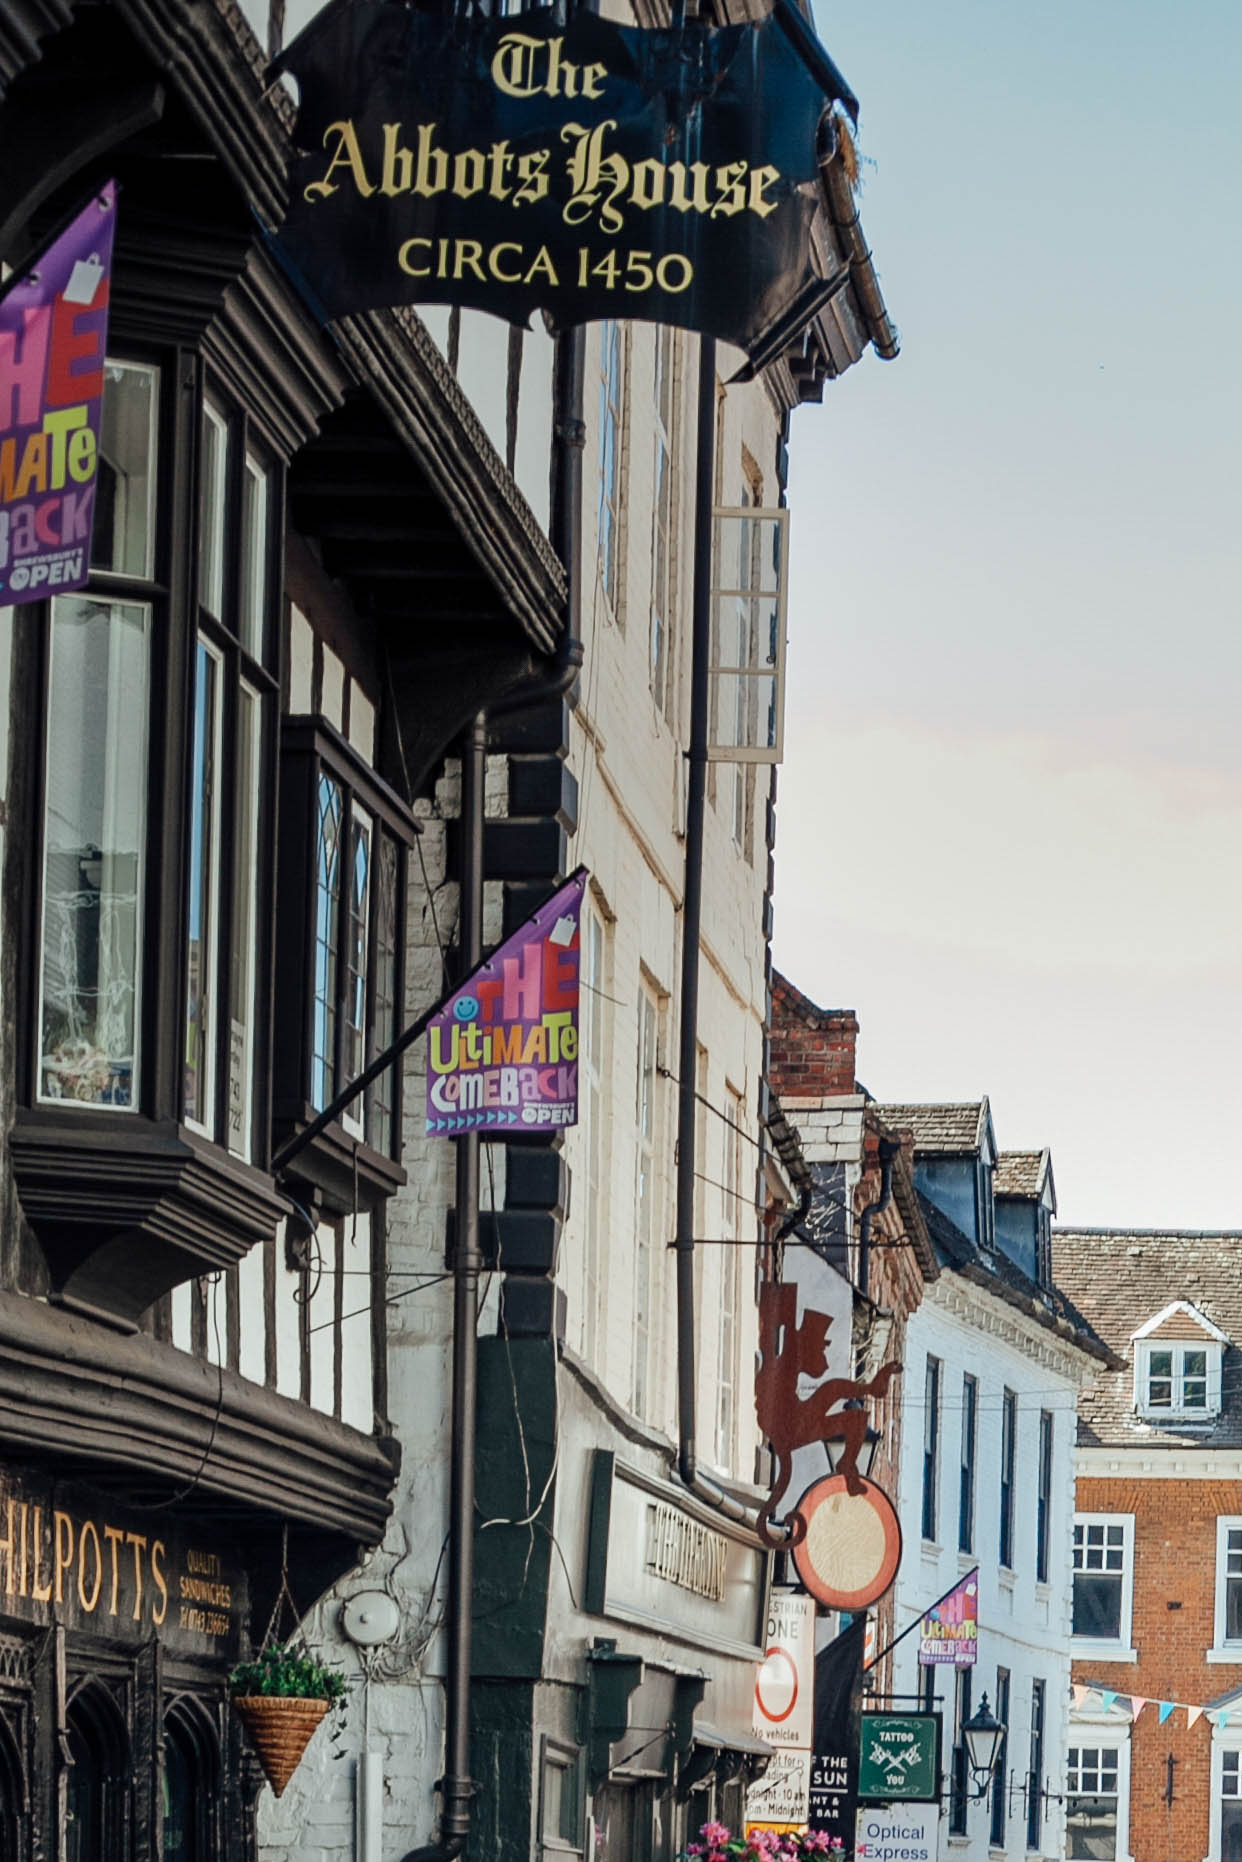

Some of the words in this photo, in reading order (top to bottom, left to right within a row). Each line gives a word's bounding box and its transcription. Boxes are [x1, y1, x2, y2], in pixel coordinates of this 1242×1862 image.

[492, 32, 609, 100] The
[304, 119, 551, 207] Abbots
[561, 120, 781, 234] House
[398, 238, 559, 286] CIRCA
[577, 247, 694, 293] 1450
[9, 557, 82, 591] OPEN
[477, 931, 579, 1021] THE
[521, 1108, 574, 1125] OPEN
[0, 1498, 168, 1626] HILPOTTS
[767, 1618, 799, 1639] ONE
[766, 1728, 800, 1741] vehicles
[879, 1731, 914, 1742] TATTOO
[821, 1755, 848, 1768] THE
[813, 1771, 848, 1785] SUN
[886, 1774, 905, 1785] YOU
[768, 1803, 804, 1818] Midnight
[816, 1808, 840, 1819] BAR
[867, 1823, 925, 1842] Optical
[864, 1843, 929, 1862] Express
